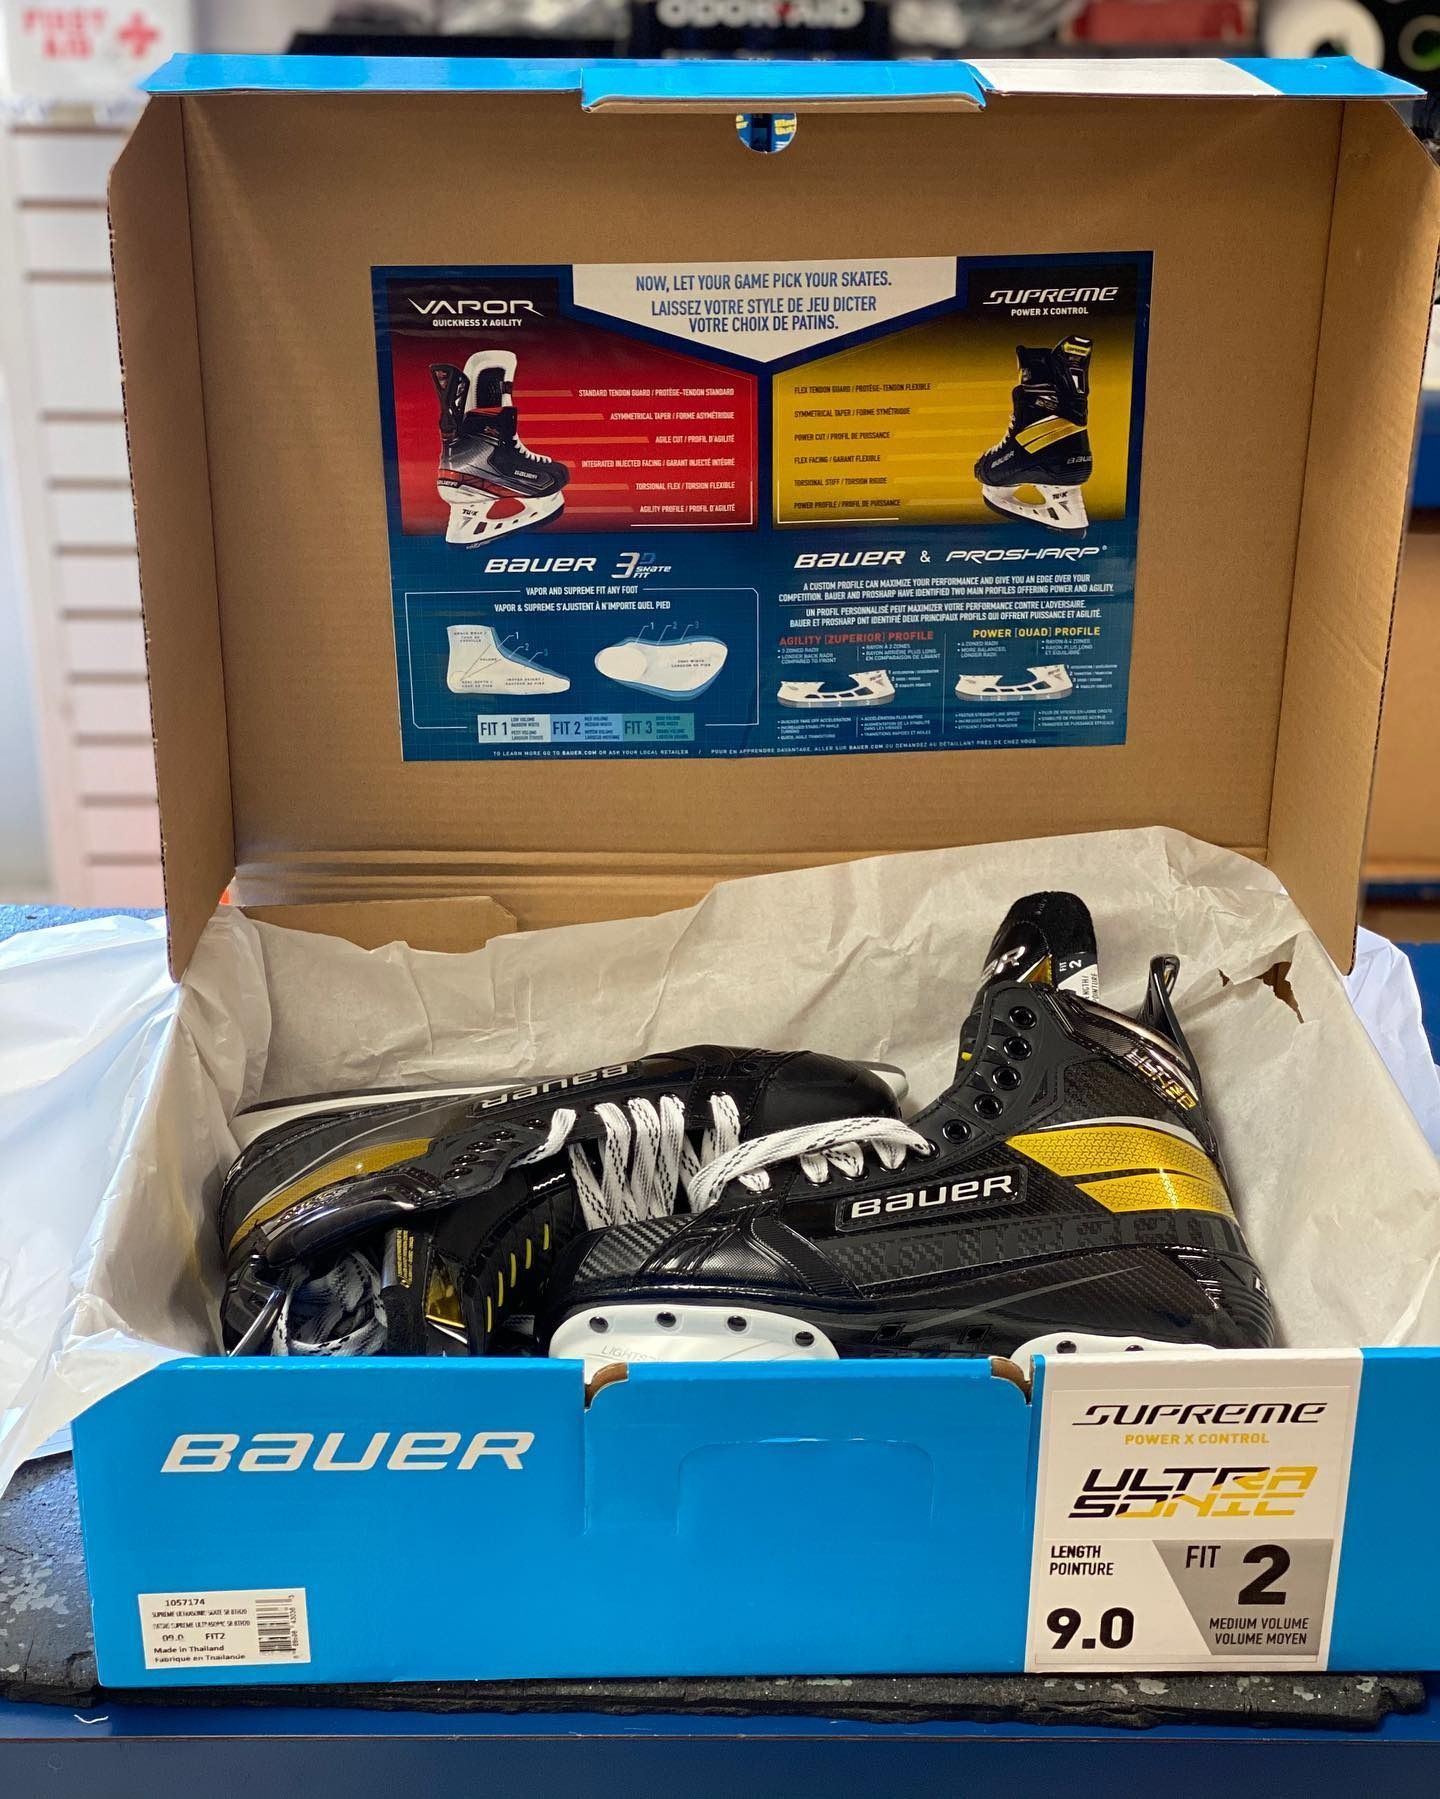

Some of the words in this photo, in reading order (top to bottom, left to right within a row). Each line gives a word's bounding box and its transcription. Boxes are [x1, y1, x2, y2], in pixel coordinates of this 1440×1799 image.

[636, 275, 670, 293] NOW,
[674, 275, 694, 290] LET
[698, 274, 730, 289] YOUR
[735, 273, 769, 289] GAME
[773, 273, 802, 288] PICK
[806, 272, 838, 287] YOUR
[842, 271, 891, 286] SKATES.
[983, 287, 1119, 304] SUPREME
[408, 298, 544, 316] VAPOR
[652, 300, 701, 316] LAISSEZ
[705, 299, 743, 315] VOTRE
[748, 298, 783, 314] STYLE
[788, 298, 802, 313] DE
[807, 297, 829, 312] JEU
[834, 296, 876, 312] DICTER
[1050, 307, 1088, 315] CONTROL
[432, 319, 480, 327] QUICKNESS
[482, 319, 487, 327] X
[490, 319, 522, 327] AGILITY
[689, 317, 729, 333] VOTRE
[732, 316, 768, 332] CHOIX
[773, 316, 788, 331] DE
[792, 315, 838, 330] PATINS.
[485, 558, 597, 573] BAUER
[794, 551, 905, 568] BAUER
[920, 550, 930, 562] &
[810, 582, 836, 590] CUSTOM
[838, 581, 864, 589] PROFILE
[880, 580, 911, 588] MAXIMIZE
[913, 579, 930, 587] YOUR
[932, 577, 979, 586] PERFORMANCE
[995, 576, 1009, 584] GIVE
[1012, 576, 1024, 584] YOU
[1037, 575, 1053, 583] EDGE
[1055, 575, 1071, 583] OVER
[526, 587, 547, 596] VAPOR
[549, 587, 562, 595] AND
[564, 587, 594, 595] SUPREME
[596, 586, 605, 594] FIT
[608, 586, 620, 594] ANY
[622, 586, 638, 594] FOOT
[825, 592, 845, 600] BAUER
[862, 590, 896, 598] PROSHARP
[916, 588, 949, 596] IDENTIFIED
[967, 587, 983, 595] MAIN
[1017, 586, 1048, 594] OFFERING
[1050, 585, 1072, 593] POWER
[495, 604, 516, 612] VAPOR
[524, 603, 554, 611] SUPREME
[556, 603, 593, 611] S'AJUSTENT
[602, 602, 635, 610] N'IMPORTE
[656, 601, 670, 609] PIED
[806, 609, 815, 617] UN
[817, 608, 839, 616] PROFIL
[945, 603, 964, 611] VOTRE
[966, 602, 1013, 610] PERFORMANCE
[1015, 601, 1039, 609] CONTRE
[822, 618, 855, 626] PROSHARP
[857, 617, 869, 625] ONT
[921, 614, 958, 622] PRINCIPAUX
[1001, 612, 1028, 620] OFFRENT
[1030, 611, 1065, 619] PUISSANCE
[780, 636, 821, 645] AGILITY
[889, 631, 933, 641] PROFILE
[973, 629, 1011, 638] POWER
[1055, 627, 1100, 636] PROFILE
[480, 722, 500, 735] FIT
[501, 722, 507, 735] 1
[553, 722, 573, 735] FIT
[575, 721, 581, 734] 2
[625, 721, 642, 734] FIT
[646, 721, 652, 734] 3
[482, 1064, 628, 1108] BAUER
[851, 1175, 1012, 1218] BAUER
[1072, 1403, 1328, 1425] SUPREME
[1125, 1434, 1180, 1445] POWER
[1184, 1434, 1194, 1444] X
[1199, 1433, 1269, 1444] CONTROL
[160, 1432, 535, 1472] BAUER
[1082, 1466, 1318, 1492] ULTRA
[1068, 1492, 1308, 1518] SONIC
[1051, 1545, 1101, 1558] LENGTH
[1050, 1562, 1114, 1576] POINTURE
[1186, 1545, 1221, 1568] FIT
[1238, 1544, 1290, 1605] 2
[1047, 1606, 1134, 1649] 9.0
[1209, 1617, 1257, 1629] MEDIUM
[1261, 1617, 1308, 1629] VOLUME
[1215, 1633, 1262, 1645] VOLUME
[1266, 1632, 1306, 1644] MOYEN
